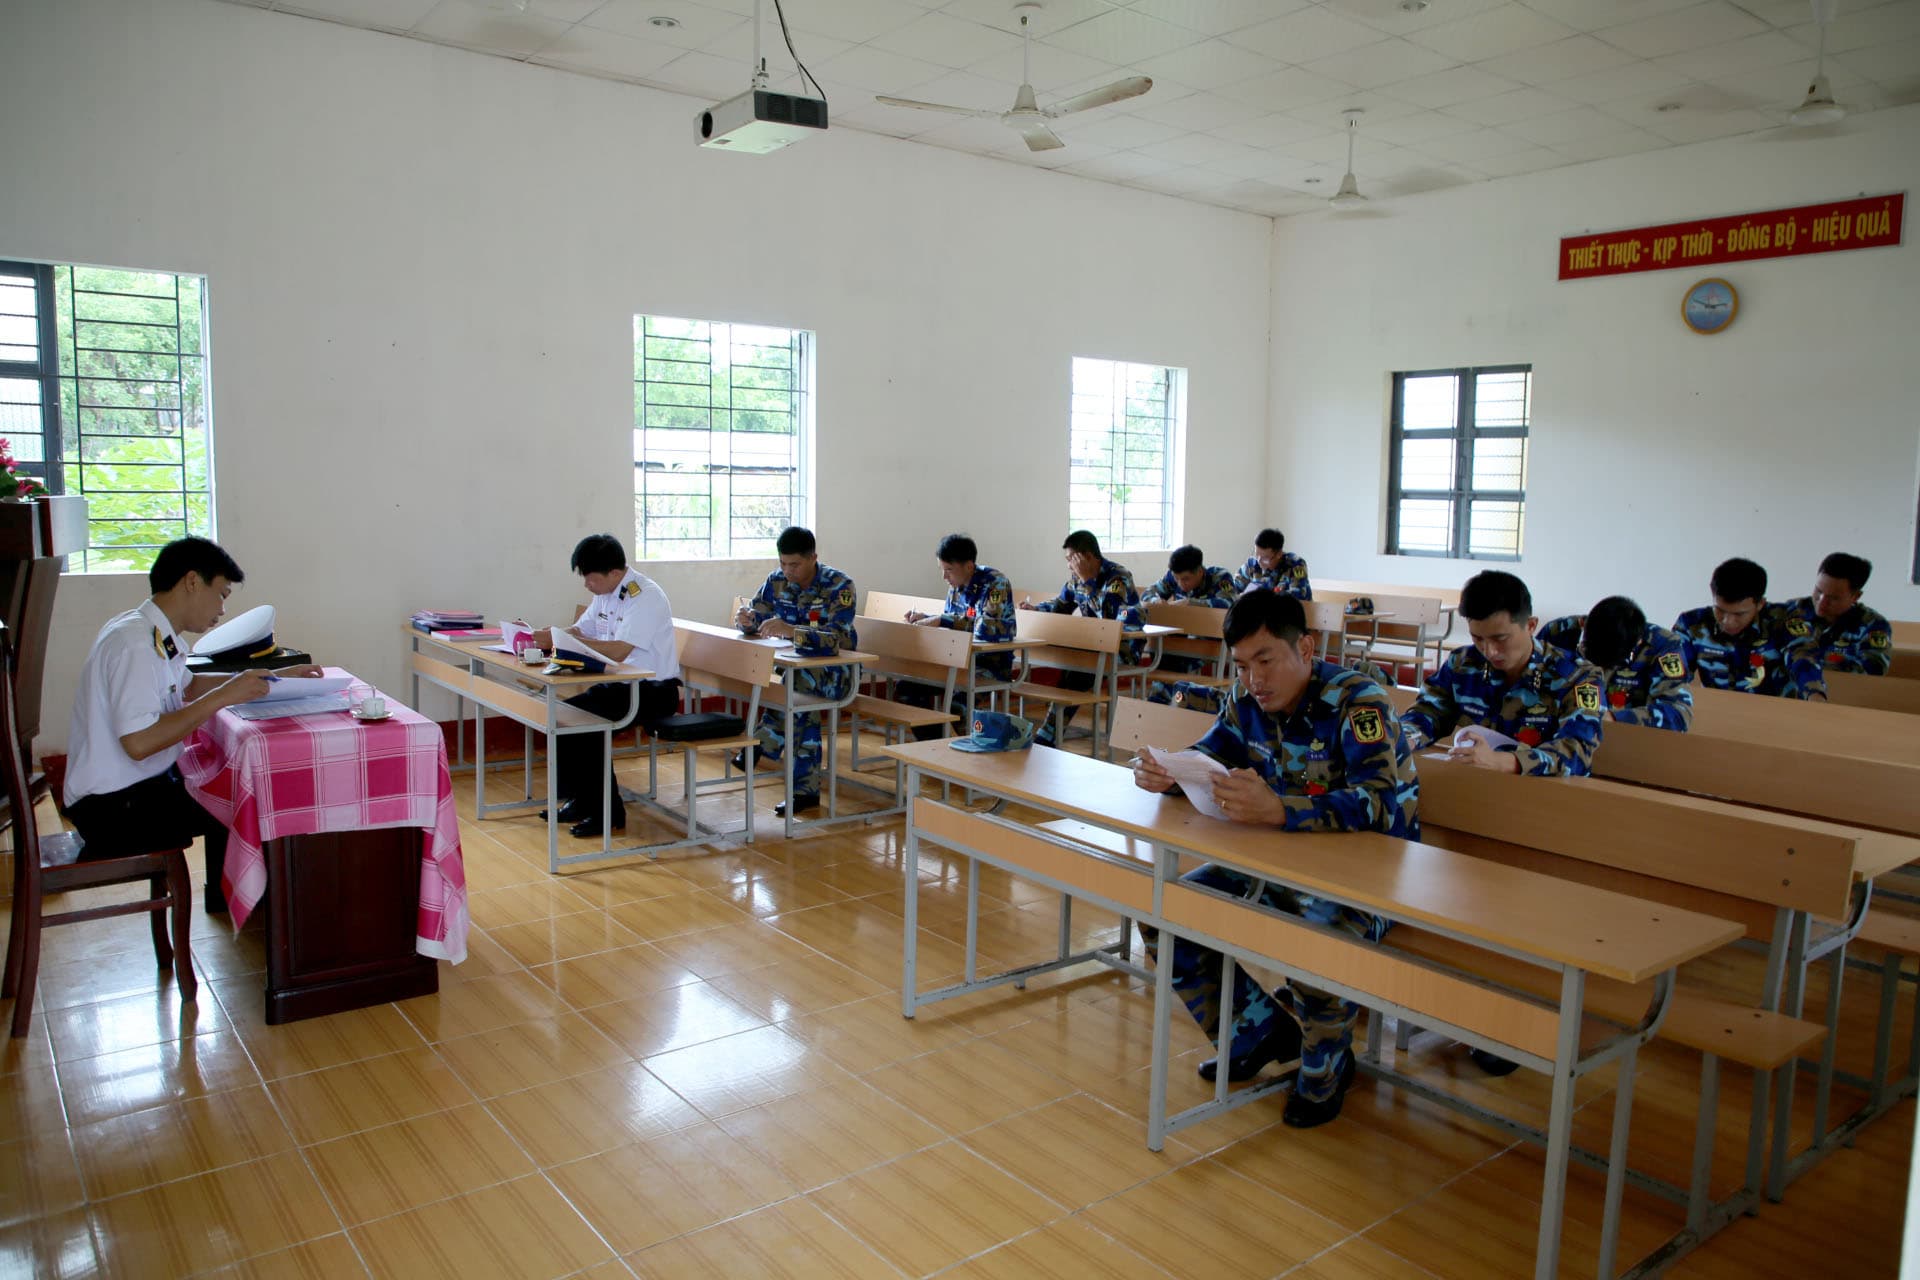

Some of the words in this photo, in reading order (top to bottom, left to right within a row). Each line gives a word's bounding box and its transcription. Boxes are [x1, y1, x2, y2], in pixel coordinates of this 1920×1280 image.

[1568, 239, 1604, 271] THIẾT
[1607, 239, 1641, 269] THỰC
[1652, 236, 1678, 264] KỊP
[1681, 227, 1714, 258] THỜI
[1774, 216, 1797, 252] BỘ
[1812, 210, 1851, 246] HIỆU
[1855, 200, 1890, 240] QUẢ
